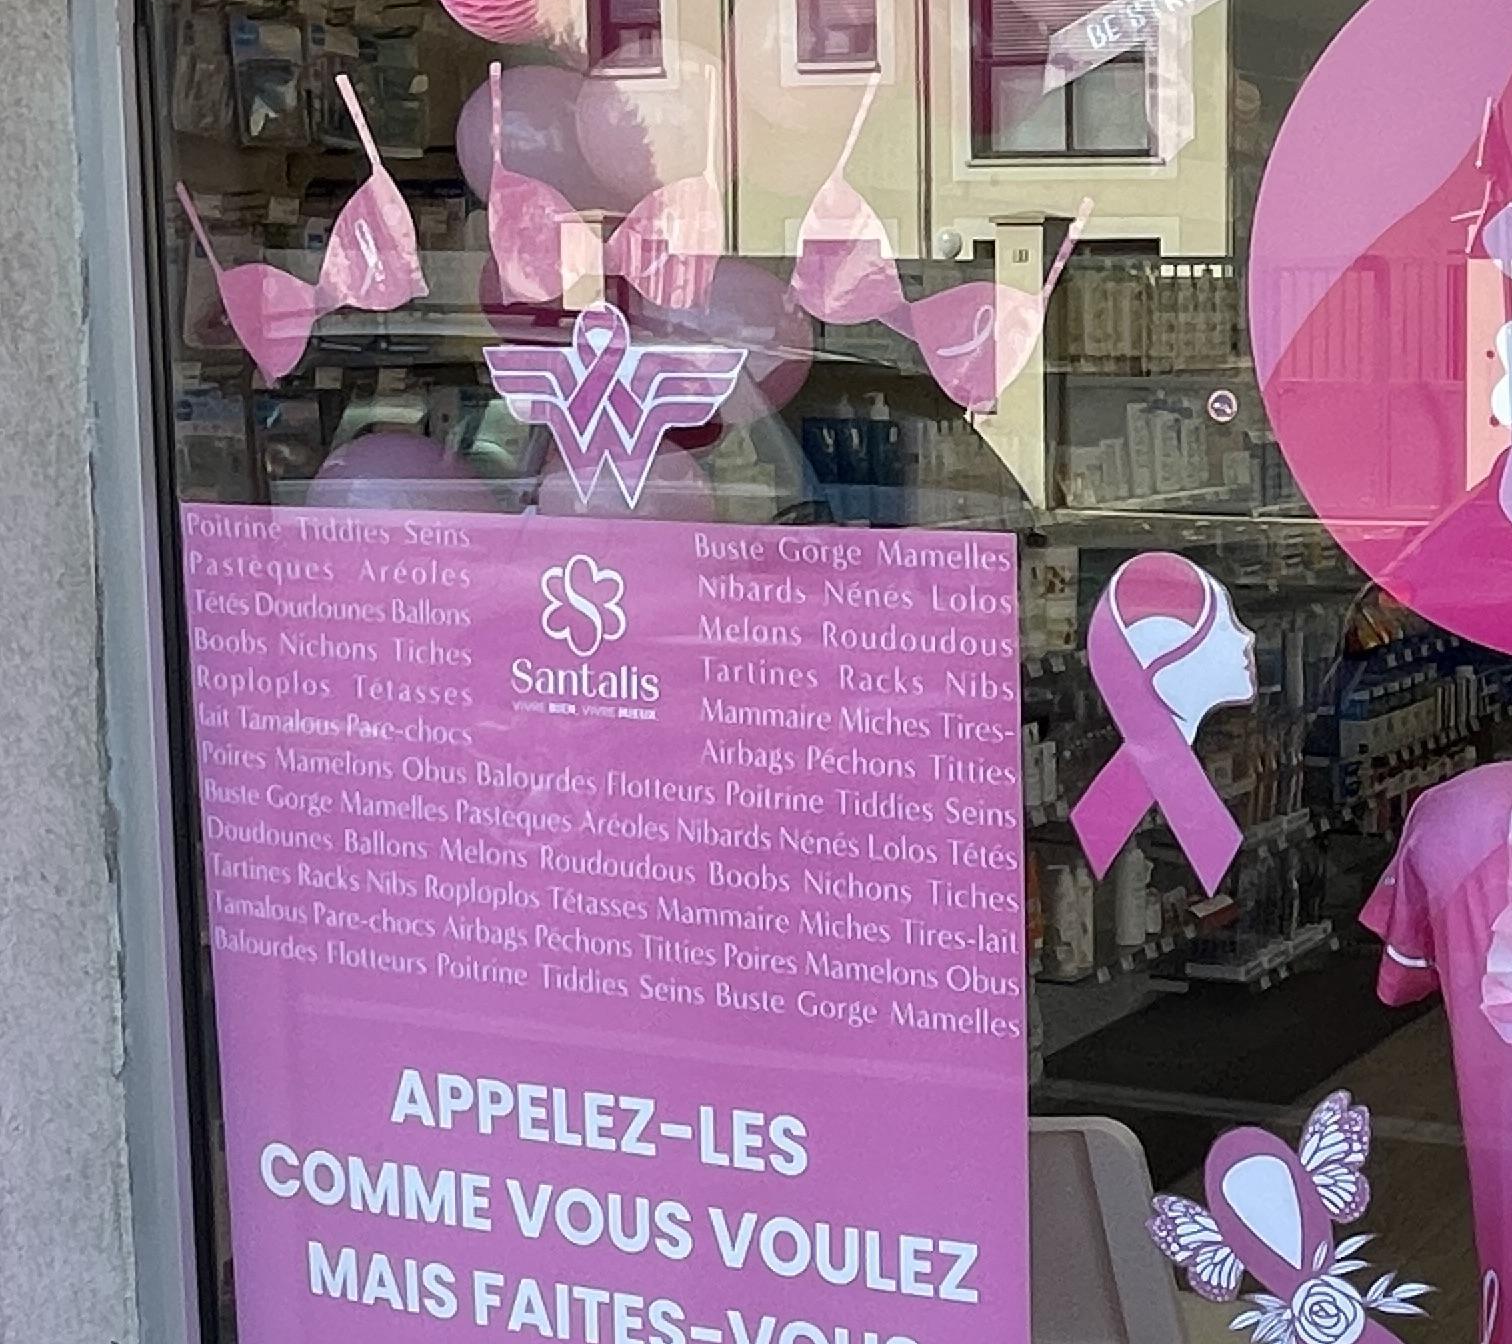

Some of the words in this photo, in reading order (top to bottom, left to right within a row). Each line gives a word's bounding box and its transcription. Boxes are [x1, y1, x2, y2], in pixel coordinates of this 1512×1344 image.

[1087, 14, 1122, 50] BE
[186, 513, 282, 539] Poitrine
[300, 517, 391, 542] Tiddies
[403, 520, 471, 545] Seins
[187, 552, 334, 584] Pastèques
[359, 558, 471, 584] Aréoles
[694, 536, 764, 561] Buste
[778, 539, 862, 570] Gorge
[878, 542, 1013, 570] Mamelles
[192, 590, 250, 615] Tétés
[255, 593, 386, 620] Doudounes
[391, 598, 471, 624] Ballons
[698, 576, 807, 603] Nibards
[824, 582, 914, 607] Nénés
[932, 586, 1015, 611] Lolos
[192, 628, 268, 654] Boobs
[280, 632, 378, 659] Nichons
[389, 637, 472, 664] Tiches
[695, 620, 802, 646] Melons
[822, 625, 1016, 656] Roudoudous
[194, 667, 331, 700] Roploplos
[351, 676, 473, 704] Tétasses
[511, 658, 660, 702] Santalis
[698, 660, 818, 689] Tartines
[839, 668, 924, 694] Racks
[946, 673, 1017, 699] Nibs
[198, 703, 231, 727] lait
[238, 706, 340, 734] Tamalous
[345, 712, 473, 743] Pare-chocs
[699, 700, 832, 730] Mammaire
[839, 708, 931, 736] Miches
[940, 714, 1016, 740] Tires-
[702, 742, 795, 775] Airbags
[807, 749, 916, 777] Péchons
[928, 756, 1019, 783] Titties
[200, 741, 266, 768] Poires
[276, 747, 393, 778] Mamelons
[402, 757, 467, 784] Obus
[476, 763, 597, 794] Balourdes
[607, 774, 716, 804] Flotteurs
[726, 783, 824, 812] Poitrine
[834, 792, 934, 821] Tiddies
[945, 801, 1019, 828] Seins
[205, 816, 333, 849] Doudounes
[344, 829, 428, 858] Ballons
[440, 838, 528, 867] Melons
[540, 847, 696, 882] Roudoudous
[709, 863, 790, 891] Boobs
[804, 871, 912, 902] Nichons
[925, 882, 1021, 912] Tiches
[212, 927, 318, 960] Balourdes
[327, 941, 427, 973] Flotteurs
[437, 954, 528, 985] Poitrine
[536, 965, 628, 996] Tiddies
[639, 976, 705, 1004] Seins
[716, 984, 785, 1013] Buste
[797, 993, 878, 1027] Gorge
[890, 1003, 1022, 1038] Mamelles
[390, 1067, 809, 1178] APPELEZ-LES
[259, 1140, 492, 1233] COMME
[506, 1177, 694, 1260] VOUS
[709, 1206, 980, 1305] VOULEZ
[306, 1240, 458, 1323] MAIS
